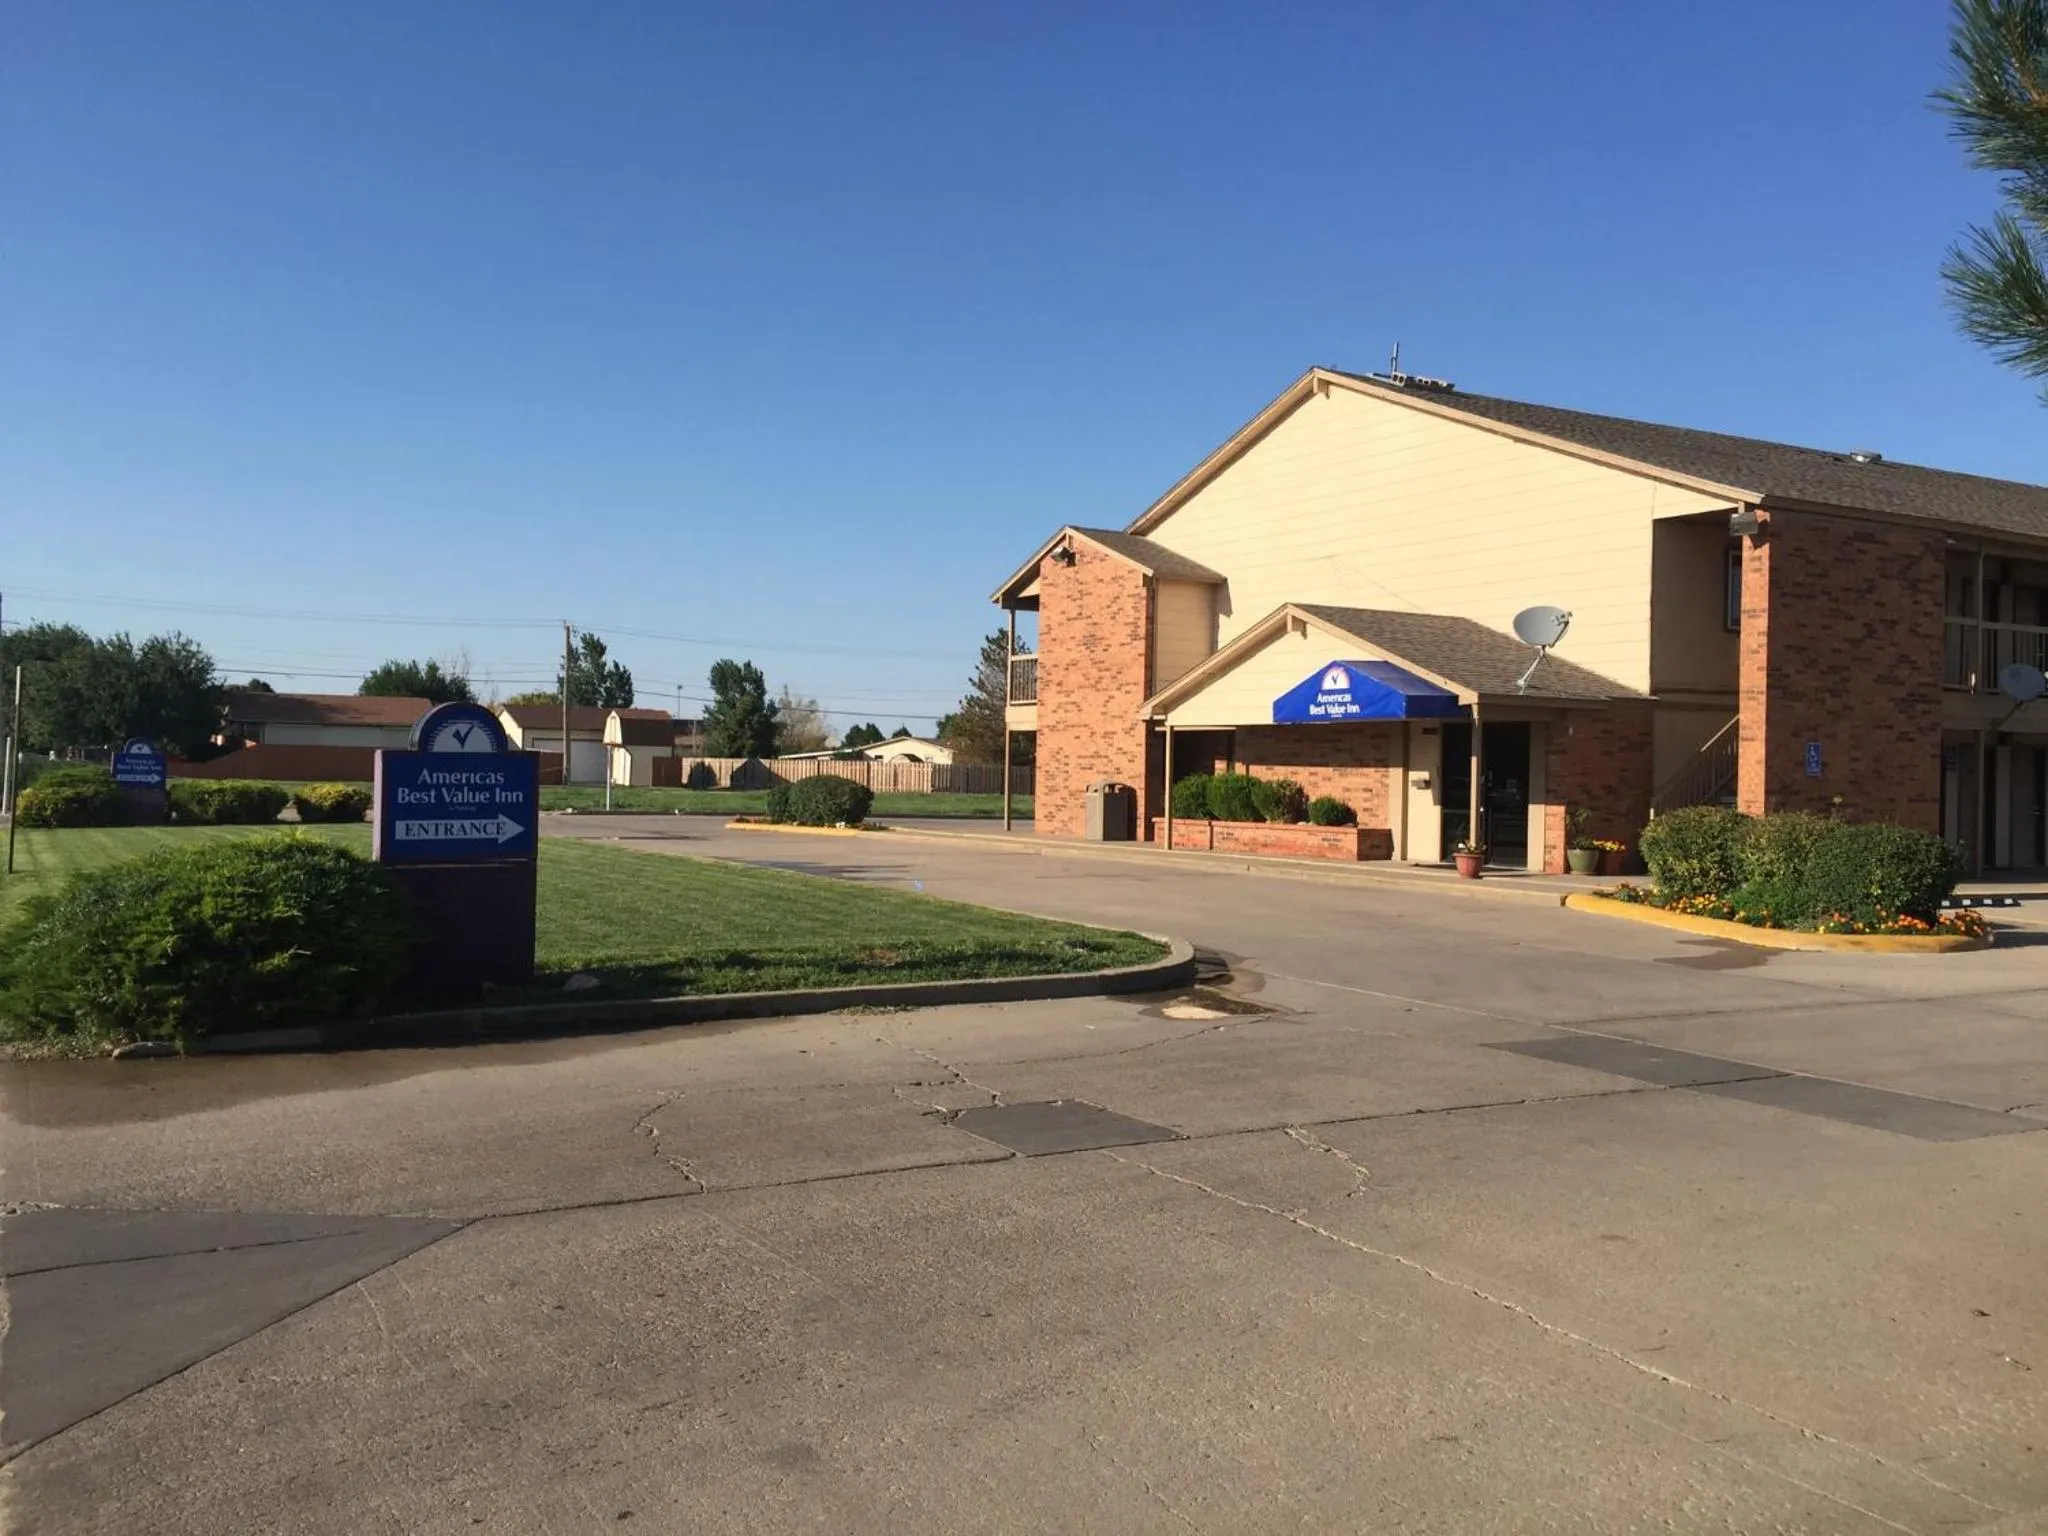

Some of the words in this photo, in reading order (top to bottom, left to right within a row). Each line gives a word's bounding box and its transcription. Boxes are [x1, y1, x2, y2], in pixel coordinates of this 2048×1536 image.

[1316, 693, 1352, 703] Americas
[1309, 704, 1325, 715] Best
[1326, 703, 1346, 714] Value
[1347, 703, 1360, 713] Inn
[417, 768, 505, 785] Americas
[397, 787, 436, 804] Best
[442, 786, 490, 804] Value
[495, 787, 524, 803] Inn
[404, 821, 507, 837] ENTRANCE
